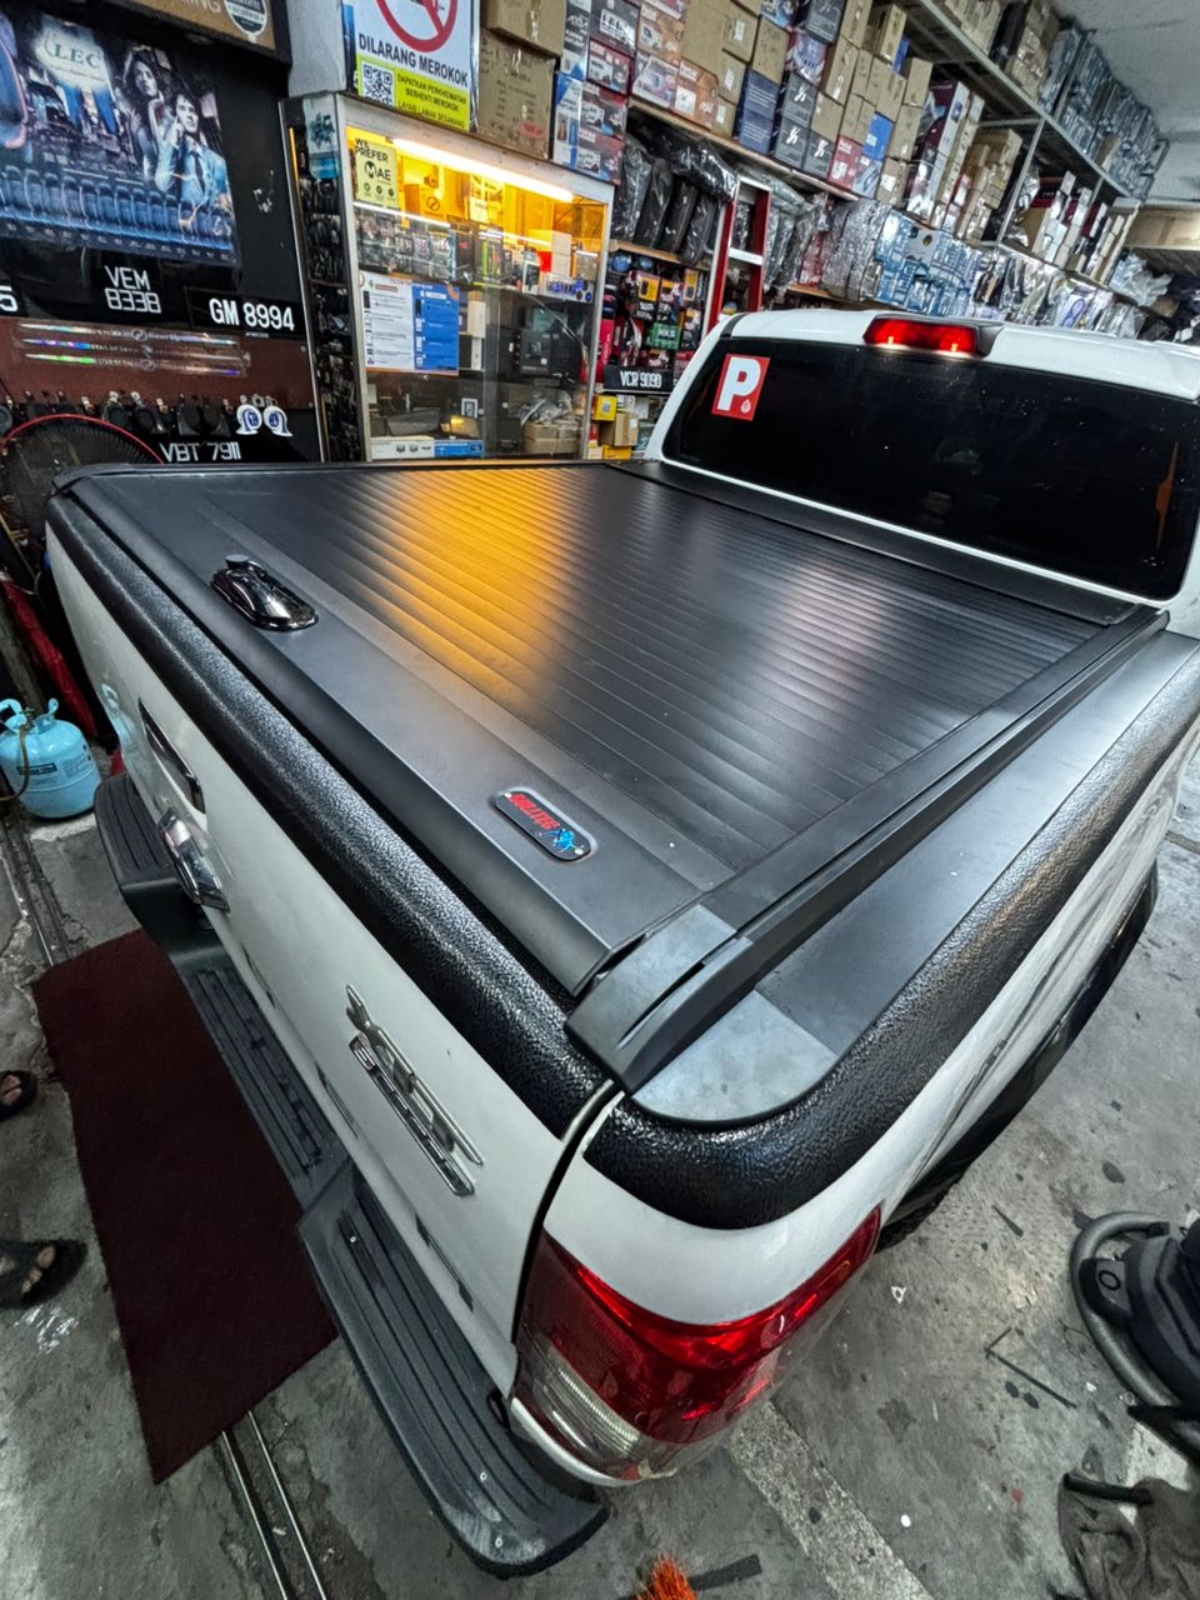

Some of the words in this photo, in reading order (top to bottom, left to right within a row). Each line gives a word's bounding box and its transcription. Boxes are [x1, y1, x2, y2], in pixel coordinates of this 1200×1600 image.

[358, 33, 416, 68] DILARANG
[419, 55, 469, 88] MEROKOK
[355, 146, 388, 163] PREFER
[104, 265, 150, 290] VEM
[208, 298, 240, 326] GM
[243, 302, 295, 331] 8994
[620, 370, 639, 387] VCR
[717, 356, 761, 411] P
[159, 442, 200, 462] VBT
